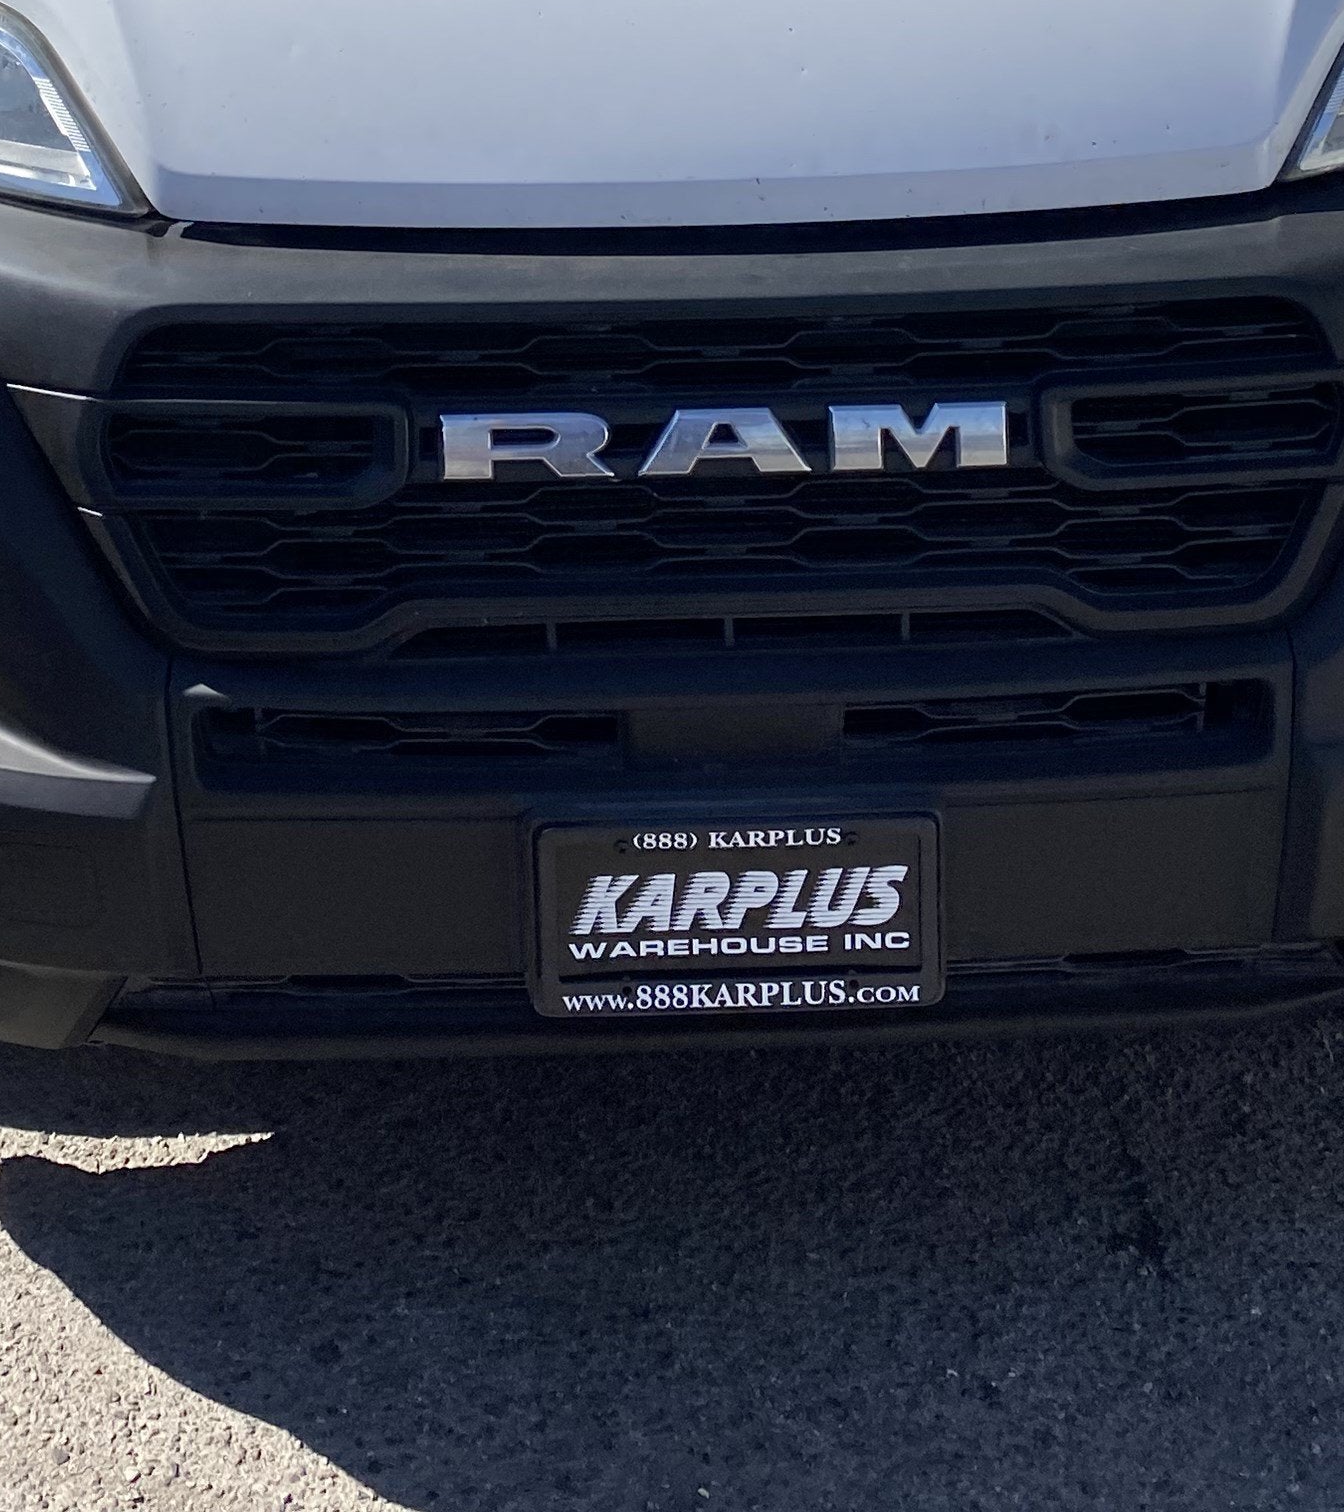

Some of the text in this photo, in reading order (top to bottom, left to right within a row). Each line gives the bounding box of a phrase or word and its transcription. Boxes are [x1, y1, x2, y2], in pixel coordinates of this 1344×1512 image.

[439, 400, 1008, 481] RAM
[632, 828, 842, 850] (888) KARPLUS
[568, 865, 910, 936] KARPLUS
[568, 931, 910, 960] WAREHOUSE INC
